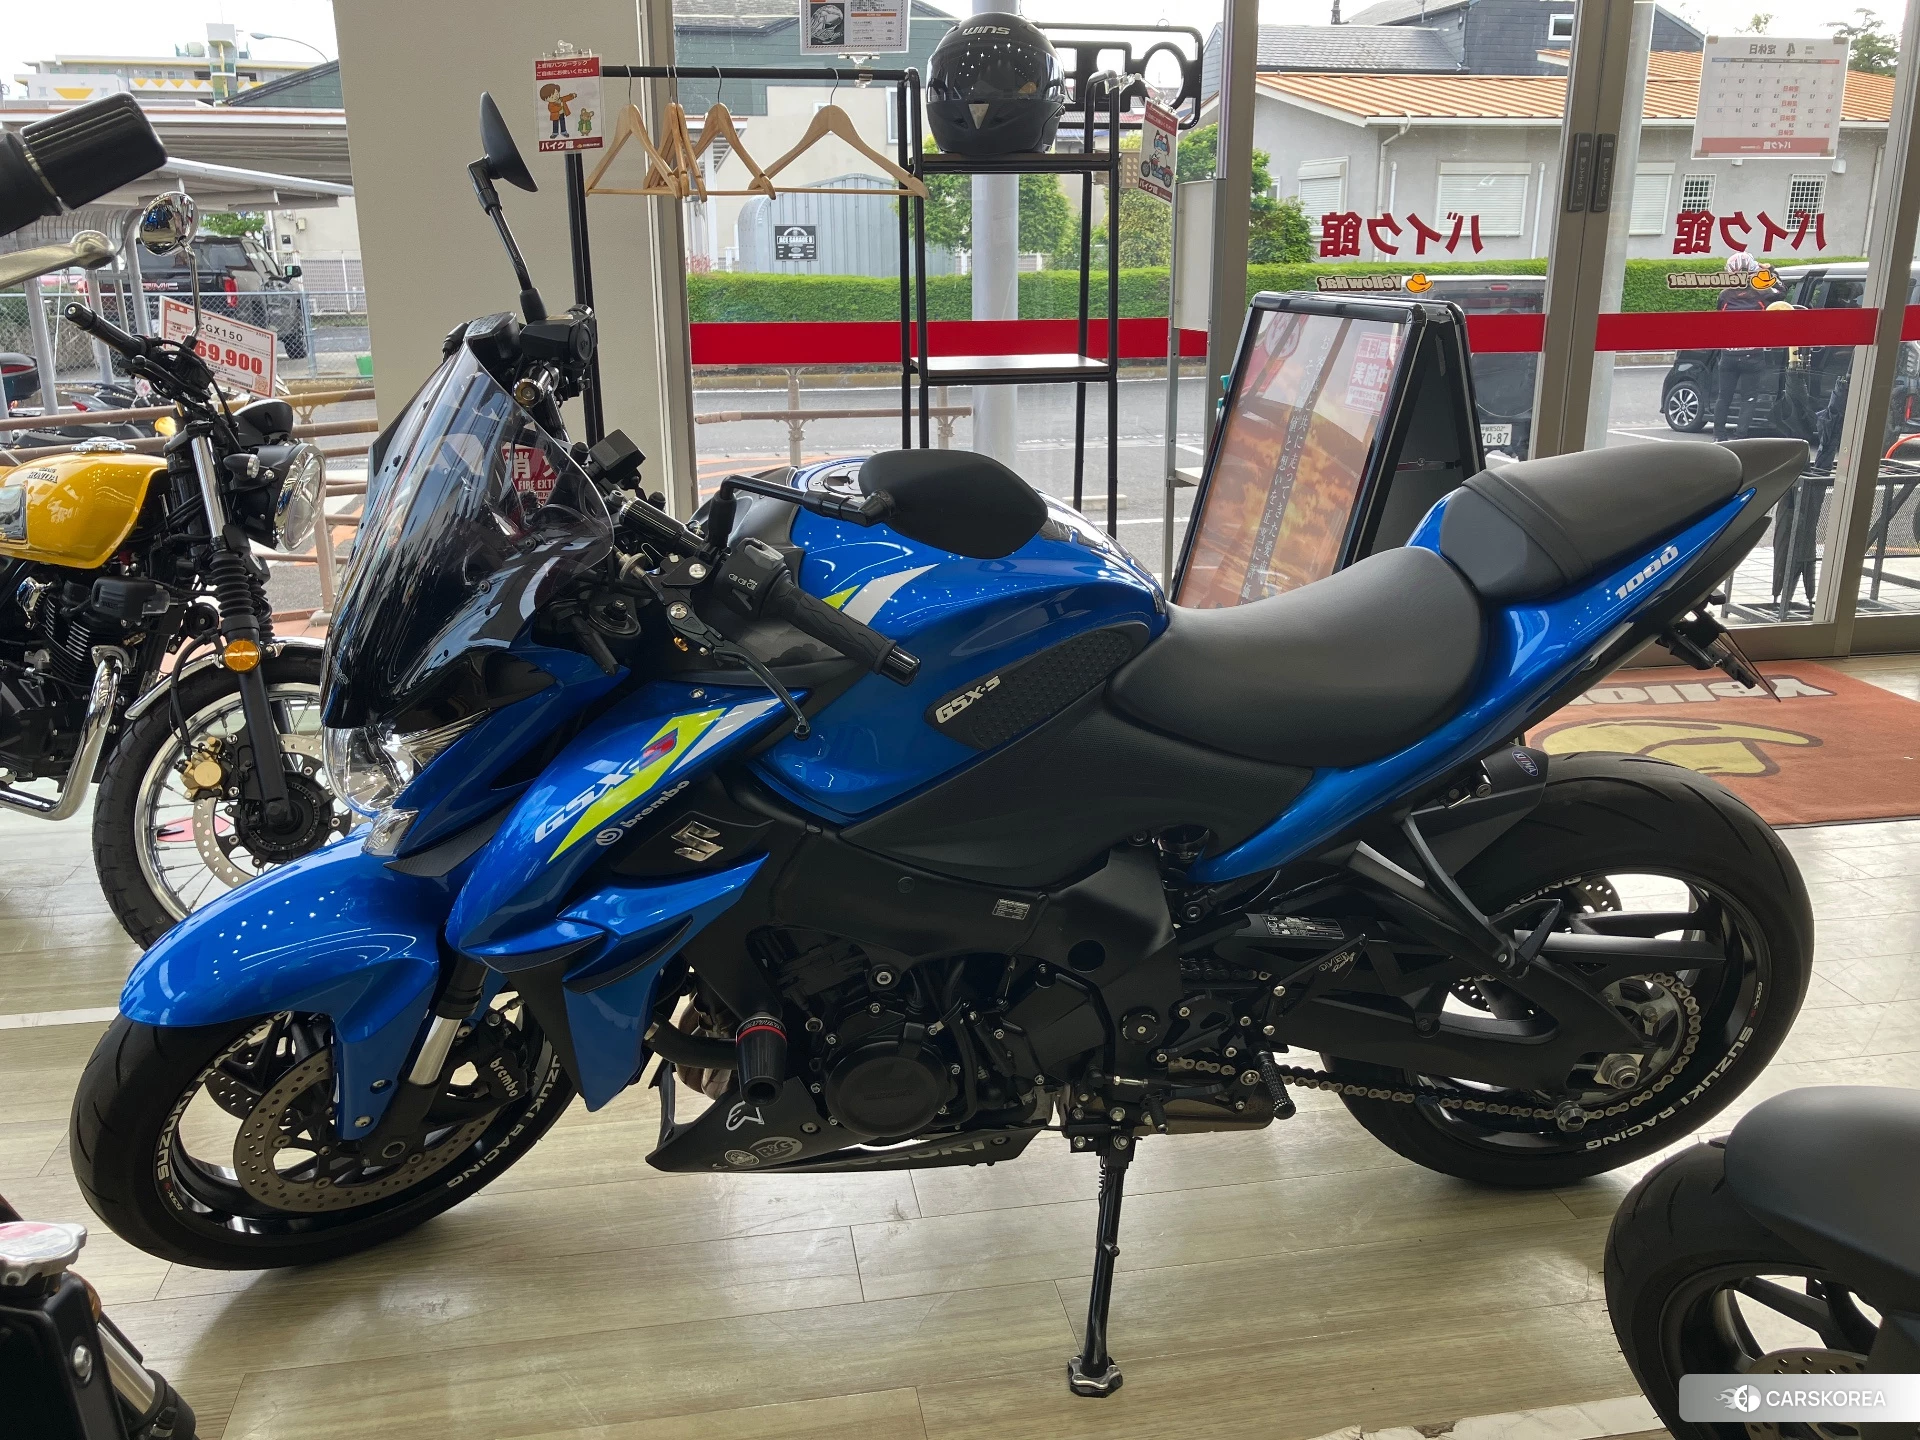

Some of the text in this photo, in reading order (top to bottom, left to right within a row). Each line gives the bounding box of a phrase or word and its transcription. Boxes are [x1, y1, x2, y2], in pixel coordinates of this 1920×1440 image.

[142, 282, 179, 290] GMC
[182, 336, 263, 375] 69,900
[27, 471, 59, 484] HONDA
[518, 480, 535, 490] FIRE
[1615, 545, 1679, 600] 1000
[935, 675, 1001, 724] GSX-S
[534, 726, 679, 844] GSX-S
[619, 780, 691, 829] brembo
[195, 1010, 295, 1084] RACING
[1680, 1026, 1754, 1106] SUZUKI
[489, 1056, 519, 1098] brembo
[525, 1053, 561, 1119] UZUKI
[157, 1090, 195, 1181] SUZUKI
[1585, 1106, 1676, 1150] RACING
[446, 1123, 526, 1188] RACING
